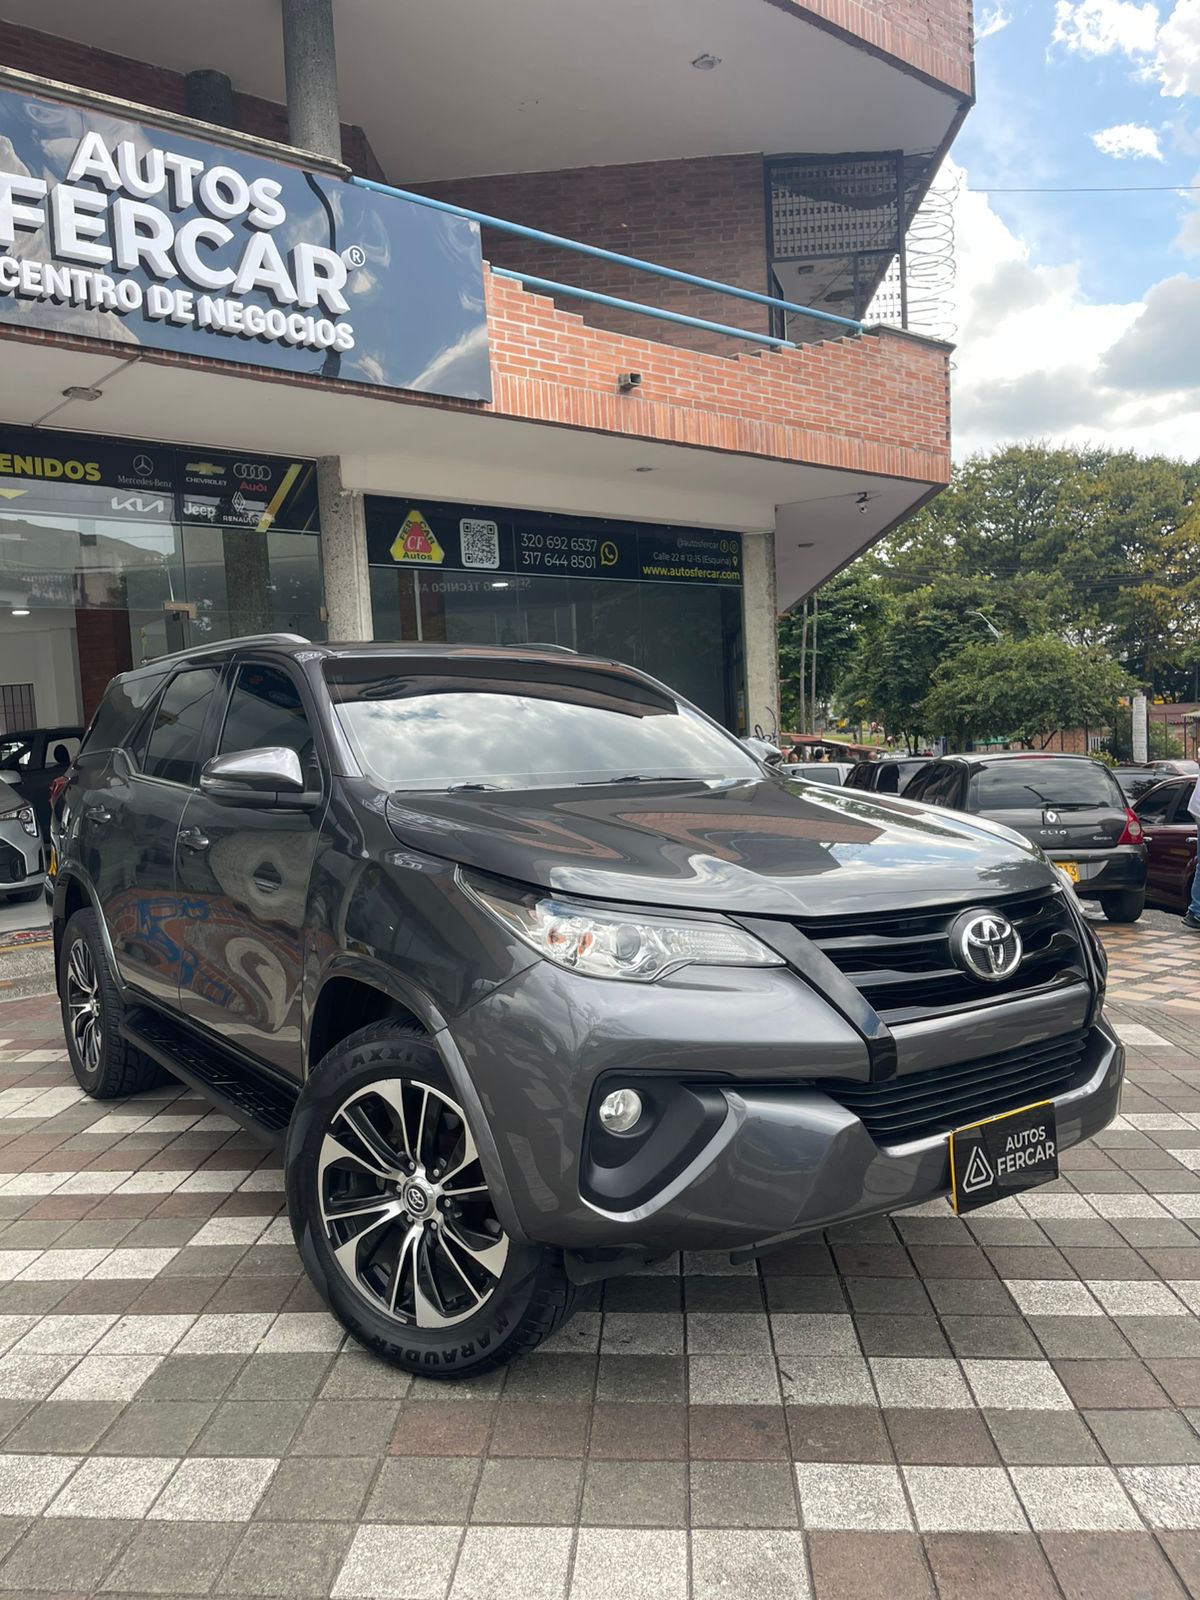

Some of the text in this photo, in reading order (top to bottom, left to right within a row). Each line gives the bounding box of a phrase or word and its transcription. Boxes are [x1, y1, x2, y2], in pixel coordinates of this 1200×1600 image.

[67, 131, 286, 231] AUTOS
[0, 171, 350, 315] FERCAR
[0, 255, 355, 352] CENTRO DE NEGOCIOS
[0, 453, 101, 481] ENIDOS
[118, 475, 172, 488] Mercedes-Benz
[186, 477, 227, 487] CHEVROLET
[239, 481, 268, 492] Audi
[111, 496, 164, 513] KIA
[183, 501, 216, 519] Jeep
[399, 519, 413, 541] FER
[420, 520, 436, 545] CAR
[407, 535, 426, 551] CF
[520, 533, 597, 552] 320 692 6537
[402, 551, 433, 561] Autos
[522, 551, 597, 569] 317 644 8501
[642, 565, 740, 580] www.autosfercar.com
[1005, 1126, 1046, 1152] AUTOS
[997, 1141, 1056, 1176] FERCAR
